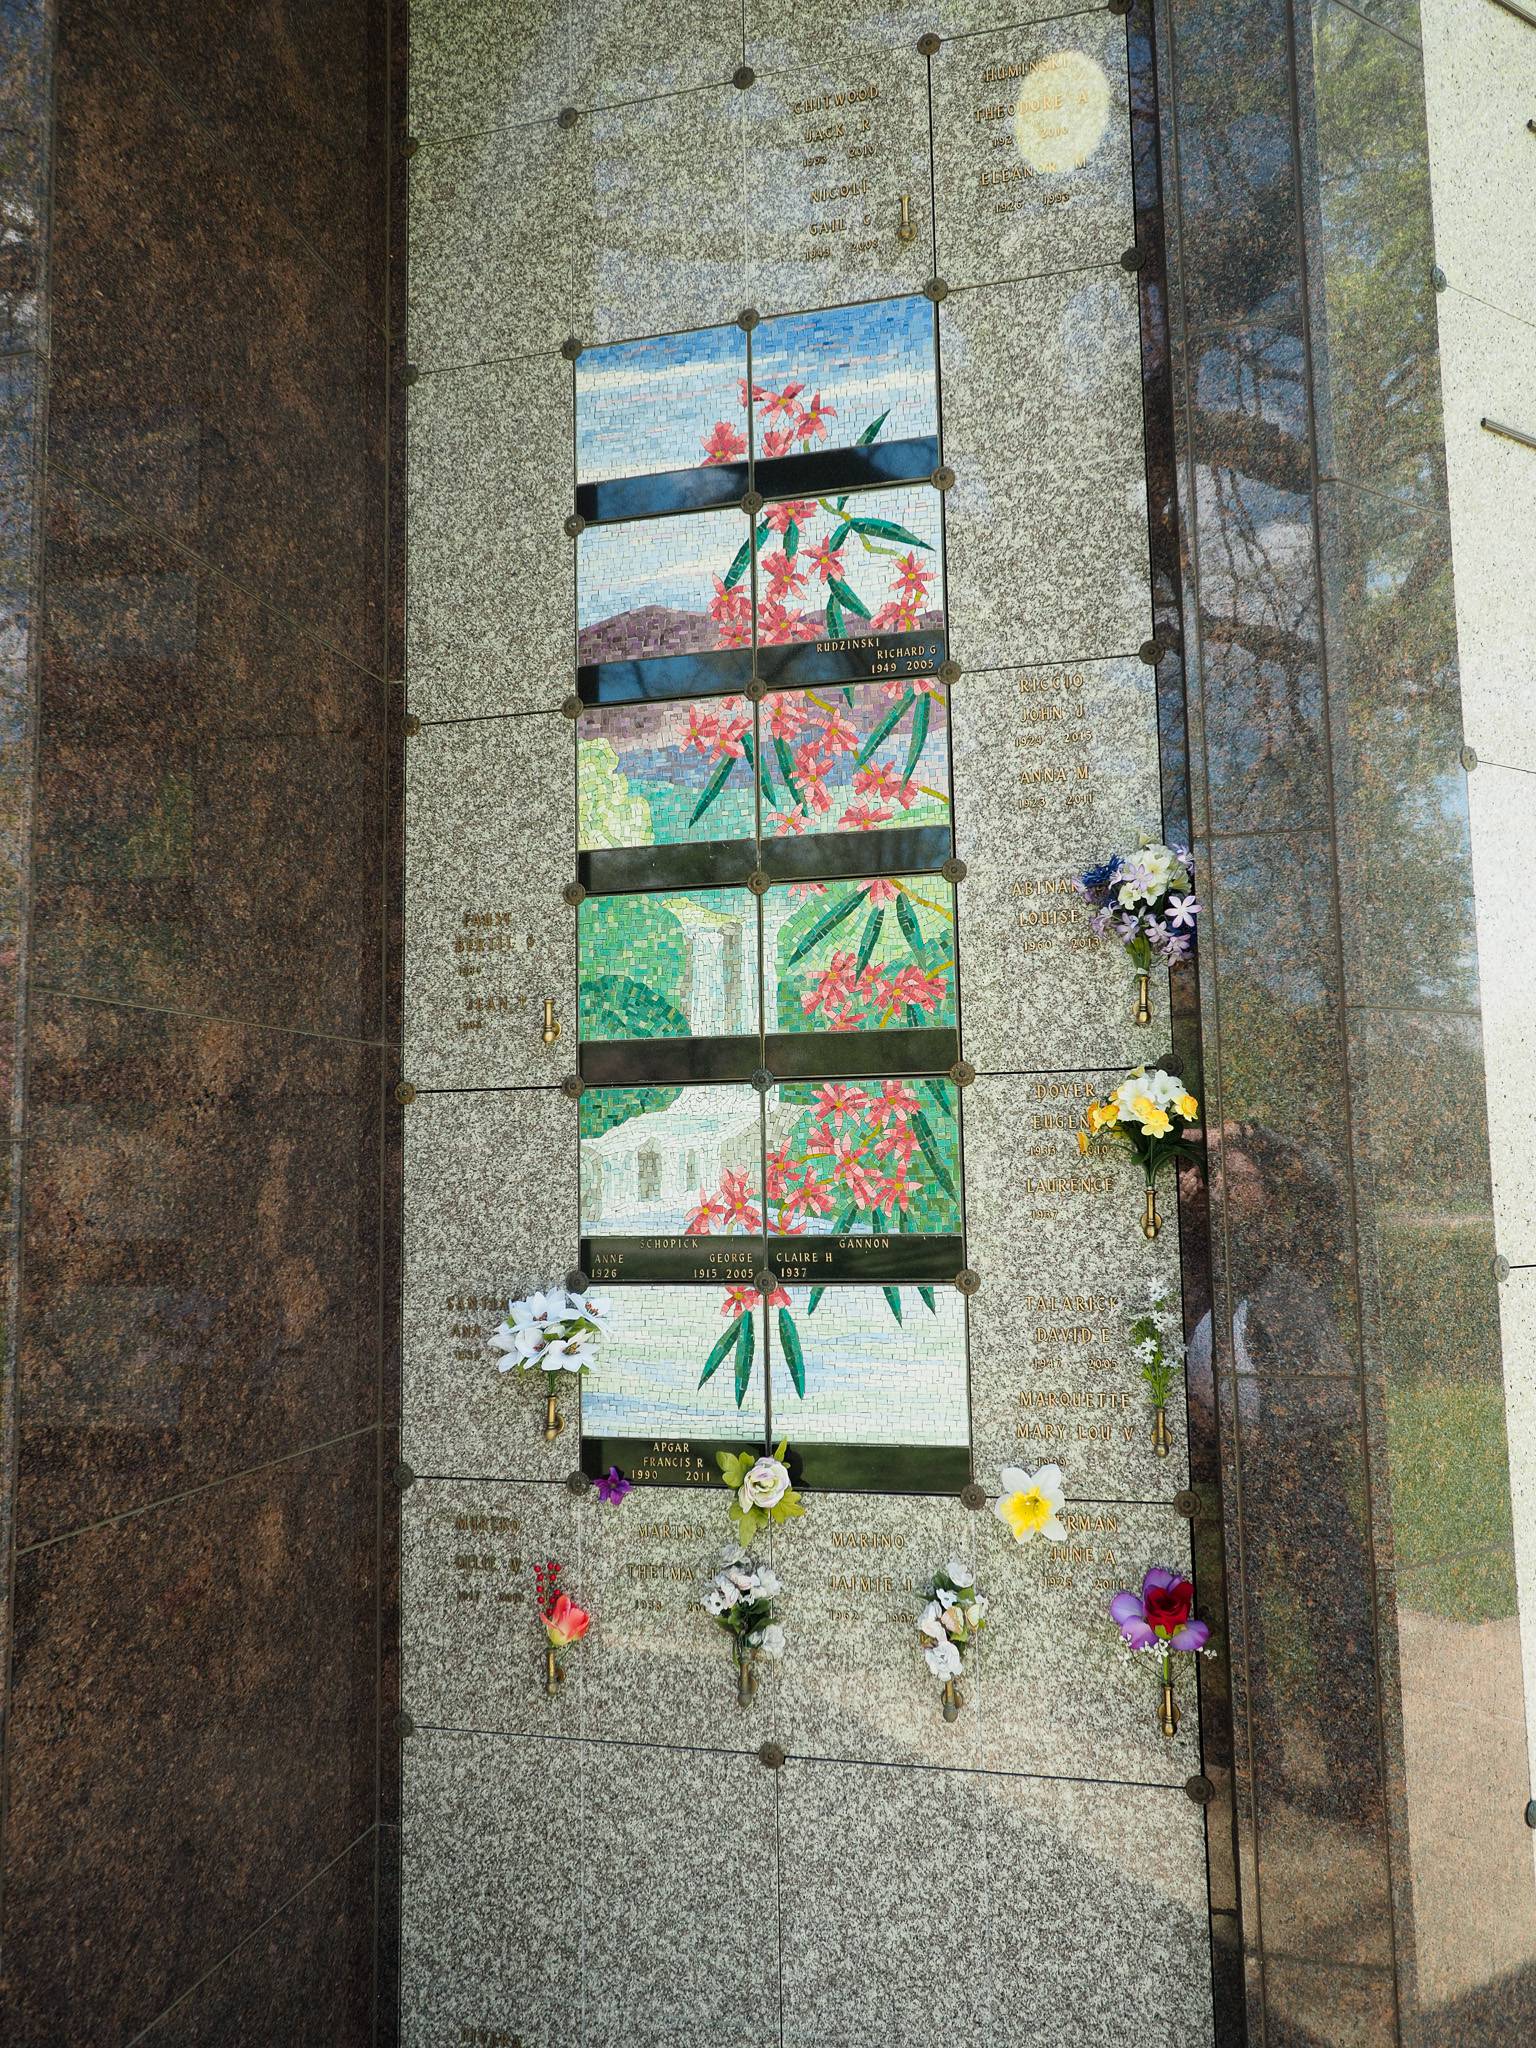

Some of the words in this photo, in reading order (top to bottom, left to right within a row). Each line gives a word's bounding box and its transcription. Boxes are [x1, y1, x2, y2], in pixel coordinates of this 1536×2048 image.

[985, 53, 1068, 82] HUMINSKI
[794, 85, 880, 114] CHITWOOD
[975, 95, 1062, 123] THEODORE
[1077, 90, 1088, 104] A
[805, 123, 844, 143] JACK
[861, 118, 870, 131] R
[981, 163, 1057, 186] ELEANOR
[1074, 156, 1087, 170] M
[810, 220, 847, 236] GAIL
[816, 637, 879, 653] RUDZINSKI
[877, 646, 924, 659] RICHARD
[930, 645, 936, 654] G
[871, 663, 897, 674] 1949
[906, 659, 934, 671] 2005
[1019, 673, 1084, 693] RICCIO
[1021, 706, 1063, 722] JOHN
[1075, 705, 1084, 718] J
[1015, 736, 1043, 747] 1924
[1064, 731, 1093, 743] 2015
[1020, 768, 1067, 784] ANNA
[1077, 766, 1089, 779] M
[1018, 798, 1046, 809] 1923
[1066, 794, 1093, 806] 2011
[1019, 909, 1081, 927] LOUISE
[1024, 941, 1052, 952] 1960
[1071, 937, 1100, 950] 2013
[1036, 1083, 1096, 1100] DOYER
[1026, 1177, 1114, 1193] LAURENCE
[640, 1239, 698, 1249] SCHOPICK
[839, 1238, 889, 1249] GANNON
[595, 1254, 624, 1264] ANNE
[709, 1253, 753, 1263] GEORGE
[776, 1252, 818, 1263] CLAIRE
[825, 1252, 833, 1263] H
[591, 1268, 617, 1278] 1926
[694, 1268, 717, 1279] 1915
[726, 1268, 754, 1279] 2005
[781, 1267, 807, 1278] 1937
[1025, 1295, 1118, 1312] TALARICK
[1037, 1327, 1093, 1344] DAVID
[1101, 1328, 1110, 1344] E
[1088, 1358, 1118, 1370] 2005
[1019, 1391, 1131, 1409] MARQUETTE
[1016, 1423, 1066, 1439] MARY
[1077, 1425, 1112, 1441] LOU
[1124, 1427, 1134, 1441] V
[653, 1442, 689, 1453] APGAR
[643, 1457, 691, 1468] FRANCIS
[697, 1458, 703, 1468] R
[632, 1470, 658, 1480] 1990
[686, 1471, 710, 1482] 2011
[1055, 1513, 1118, 1532] RMAN
[638, 1523, 705, 1539] MARINO
[832, 1532, 905, 1549] MARINO
[1051, 1548, 1094, 1563] JUNE
[1104, 1549, 1116, 1565] A
[628, 1565, 694, 1581] THELMA
[830, 1575, 893, 1593] JAIMIE
